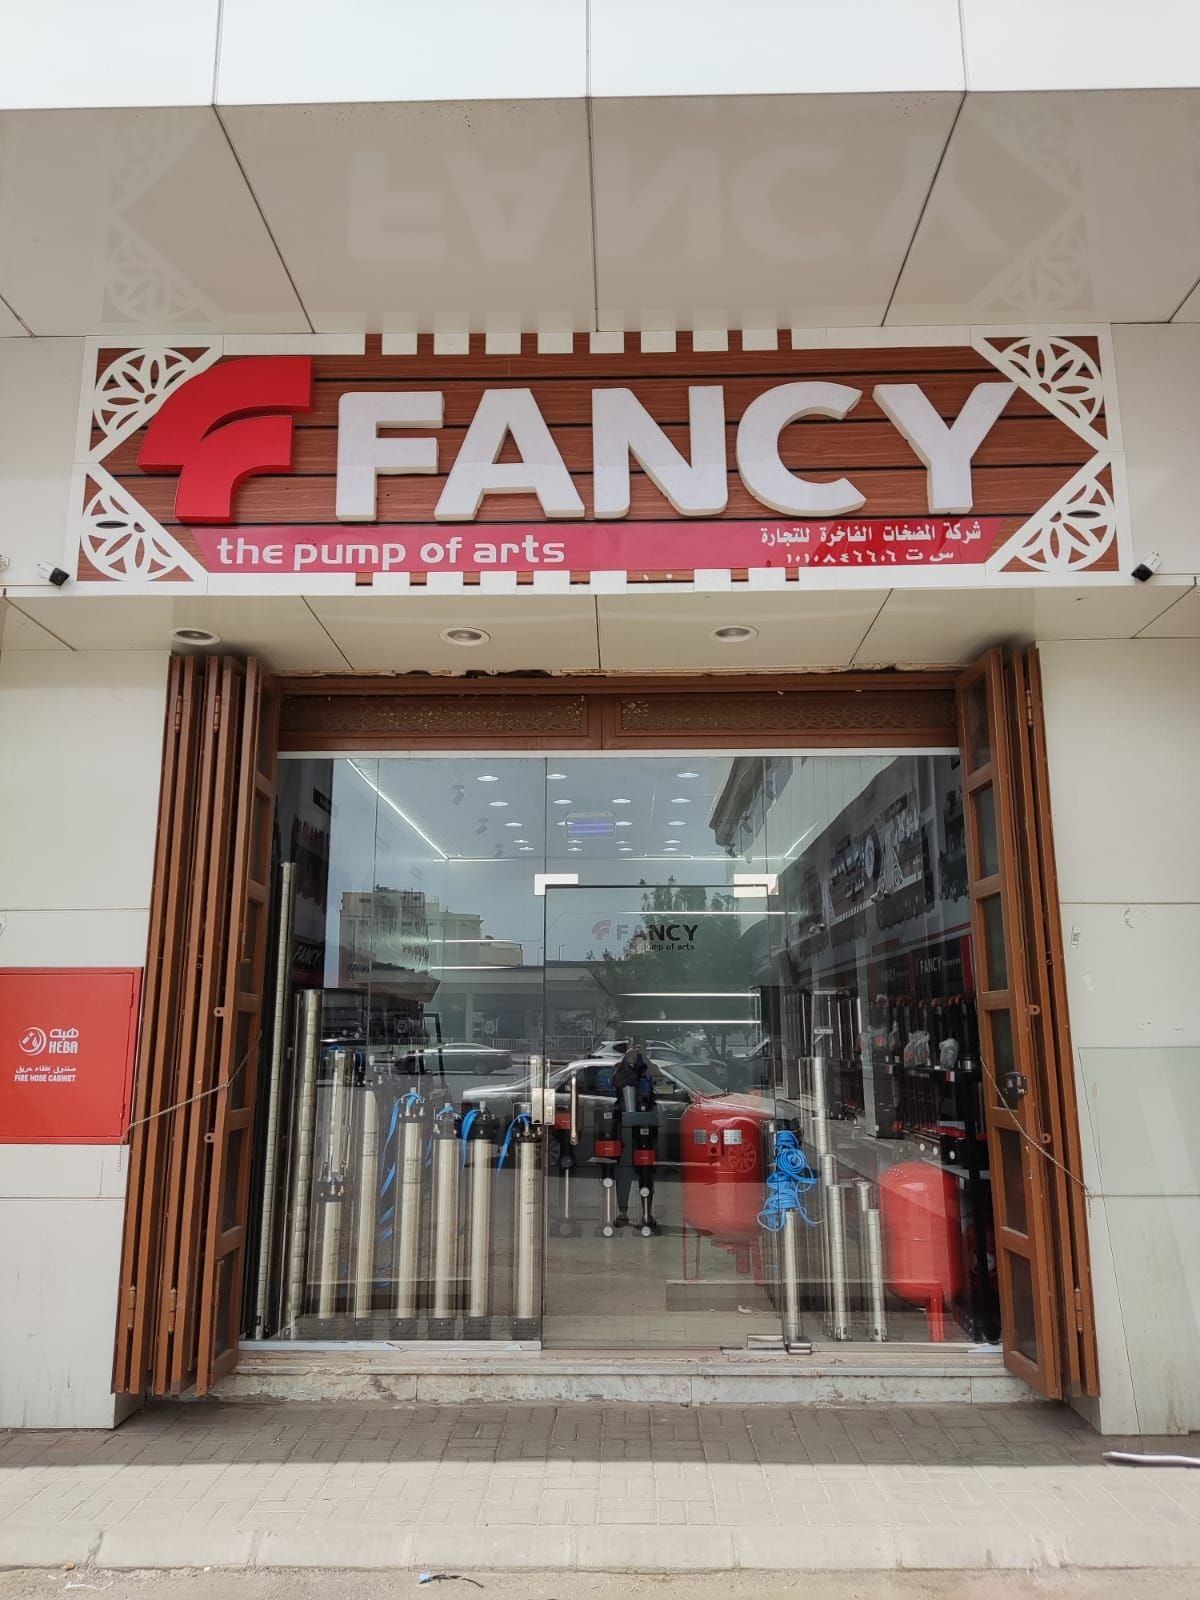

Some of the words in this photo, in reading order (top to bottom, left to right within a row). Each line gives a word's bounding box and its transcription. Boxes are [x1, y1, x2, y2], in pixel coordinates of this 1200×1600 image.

[336, 381, 1019, 522] FANCY
[760, 527, 810, 547] للتجارة
[820, 527, 872, 547] الفاخرة
[883, 524, 935, 541] المضخات
[943, 521, 981, 544] شركة
[217, 537, 284, 565] the
[293, 543, 407, 571] pump
[420, 537, 462, 564] of
[473, 534, 566, 564] arts
[905, 549, 924, 560] ت
[929, 551, 954, 562] س
[616, 924, 699, 941] FANCY
[677, 943, 696, 951] arts
[49, 1041, 78, 1053] HEBA
